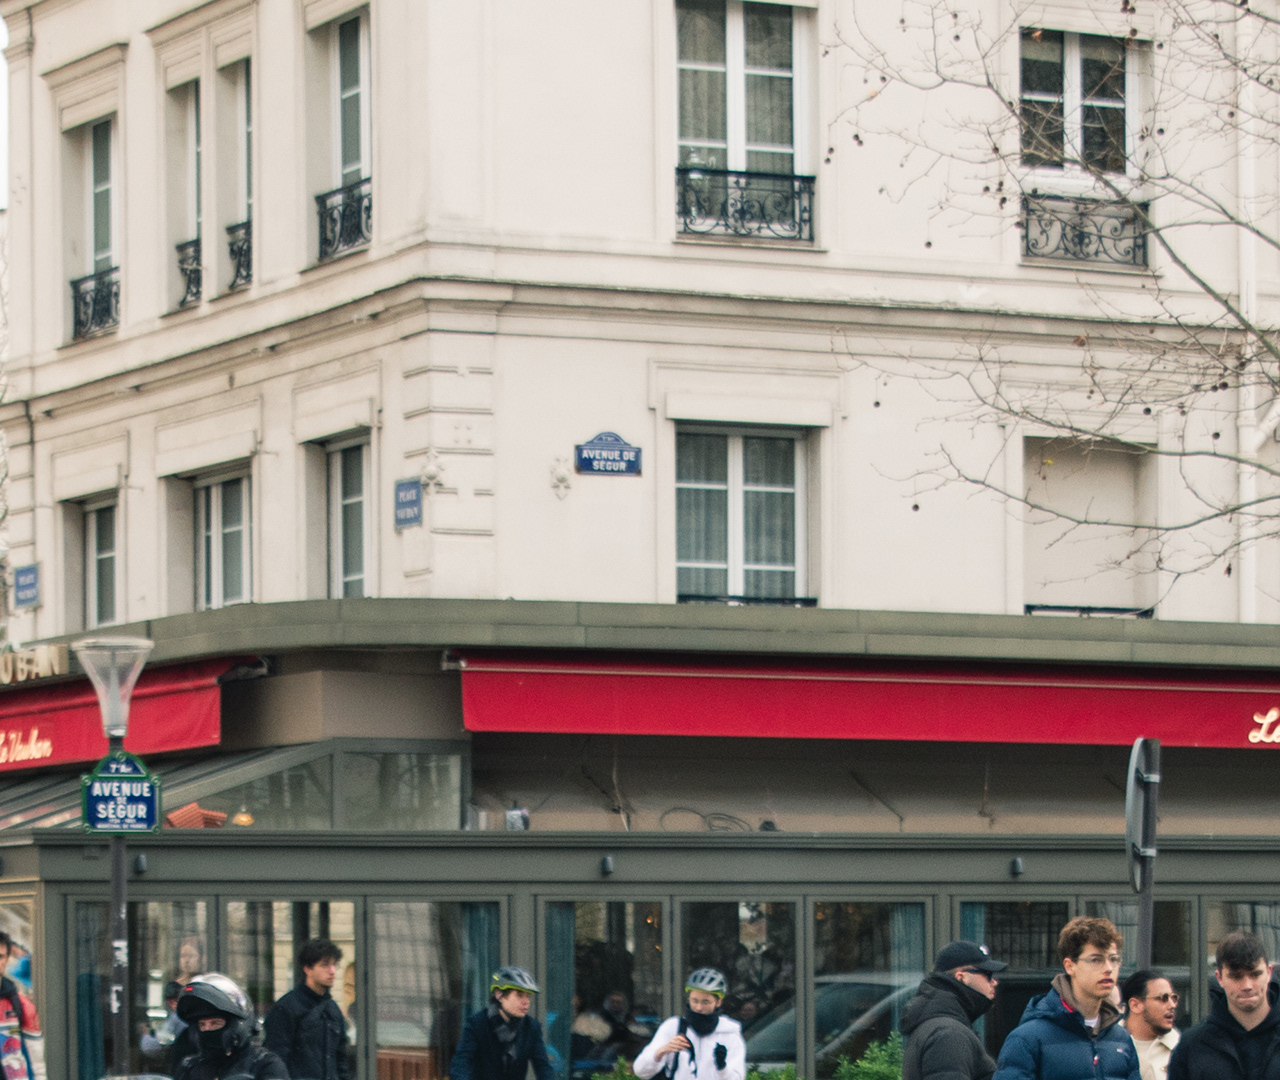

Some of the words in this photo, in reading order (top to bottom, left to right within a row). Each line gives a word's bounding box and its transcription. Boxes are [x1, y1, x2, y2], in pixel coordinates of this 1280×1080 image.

[582, 450, 621, 460] AVENUE
[623, 451, 636, 461] DE
[8, 726, 53, 762] Vauban
[92, 782, 151, 797] AVENUE
[116, 797, 127, 805] DE
[97, 801, 147, 818] SÉGUR
